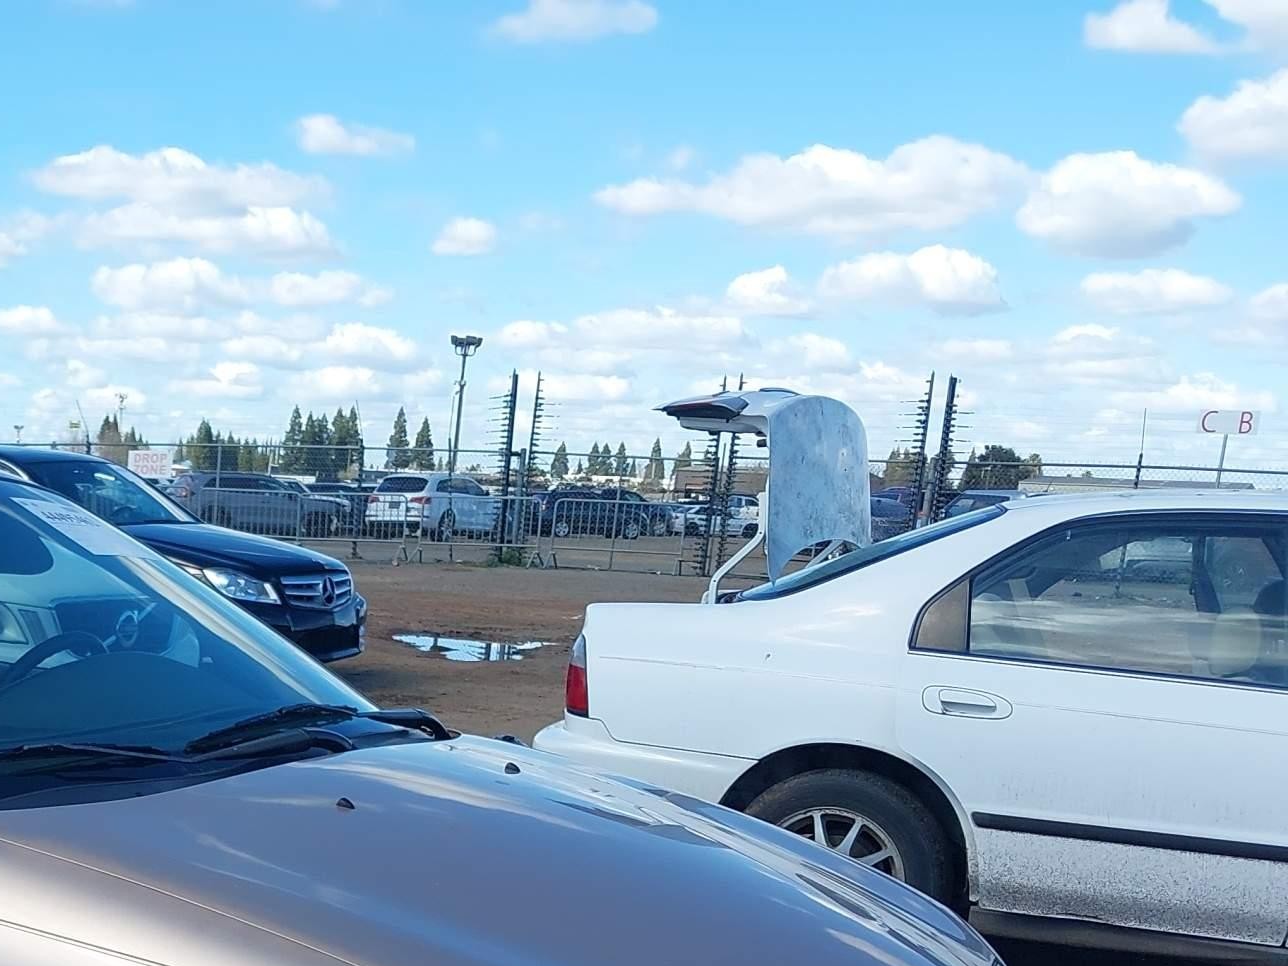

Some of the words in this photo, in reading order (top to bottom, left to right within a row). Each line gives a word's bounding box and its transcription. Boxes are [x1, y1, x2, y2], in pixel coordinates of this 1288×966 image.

[1201, 410, 1219, 433] C
[1238, 411, 1253, 434] B
[134, 453, 168, 464] DROP
[133, 464, 168, 475] ZONE
